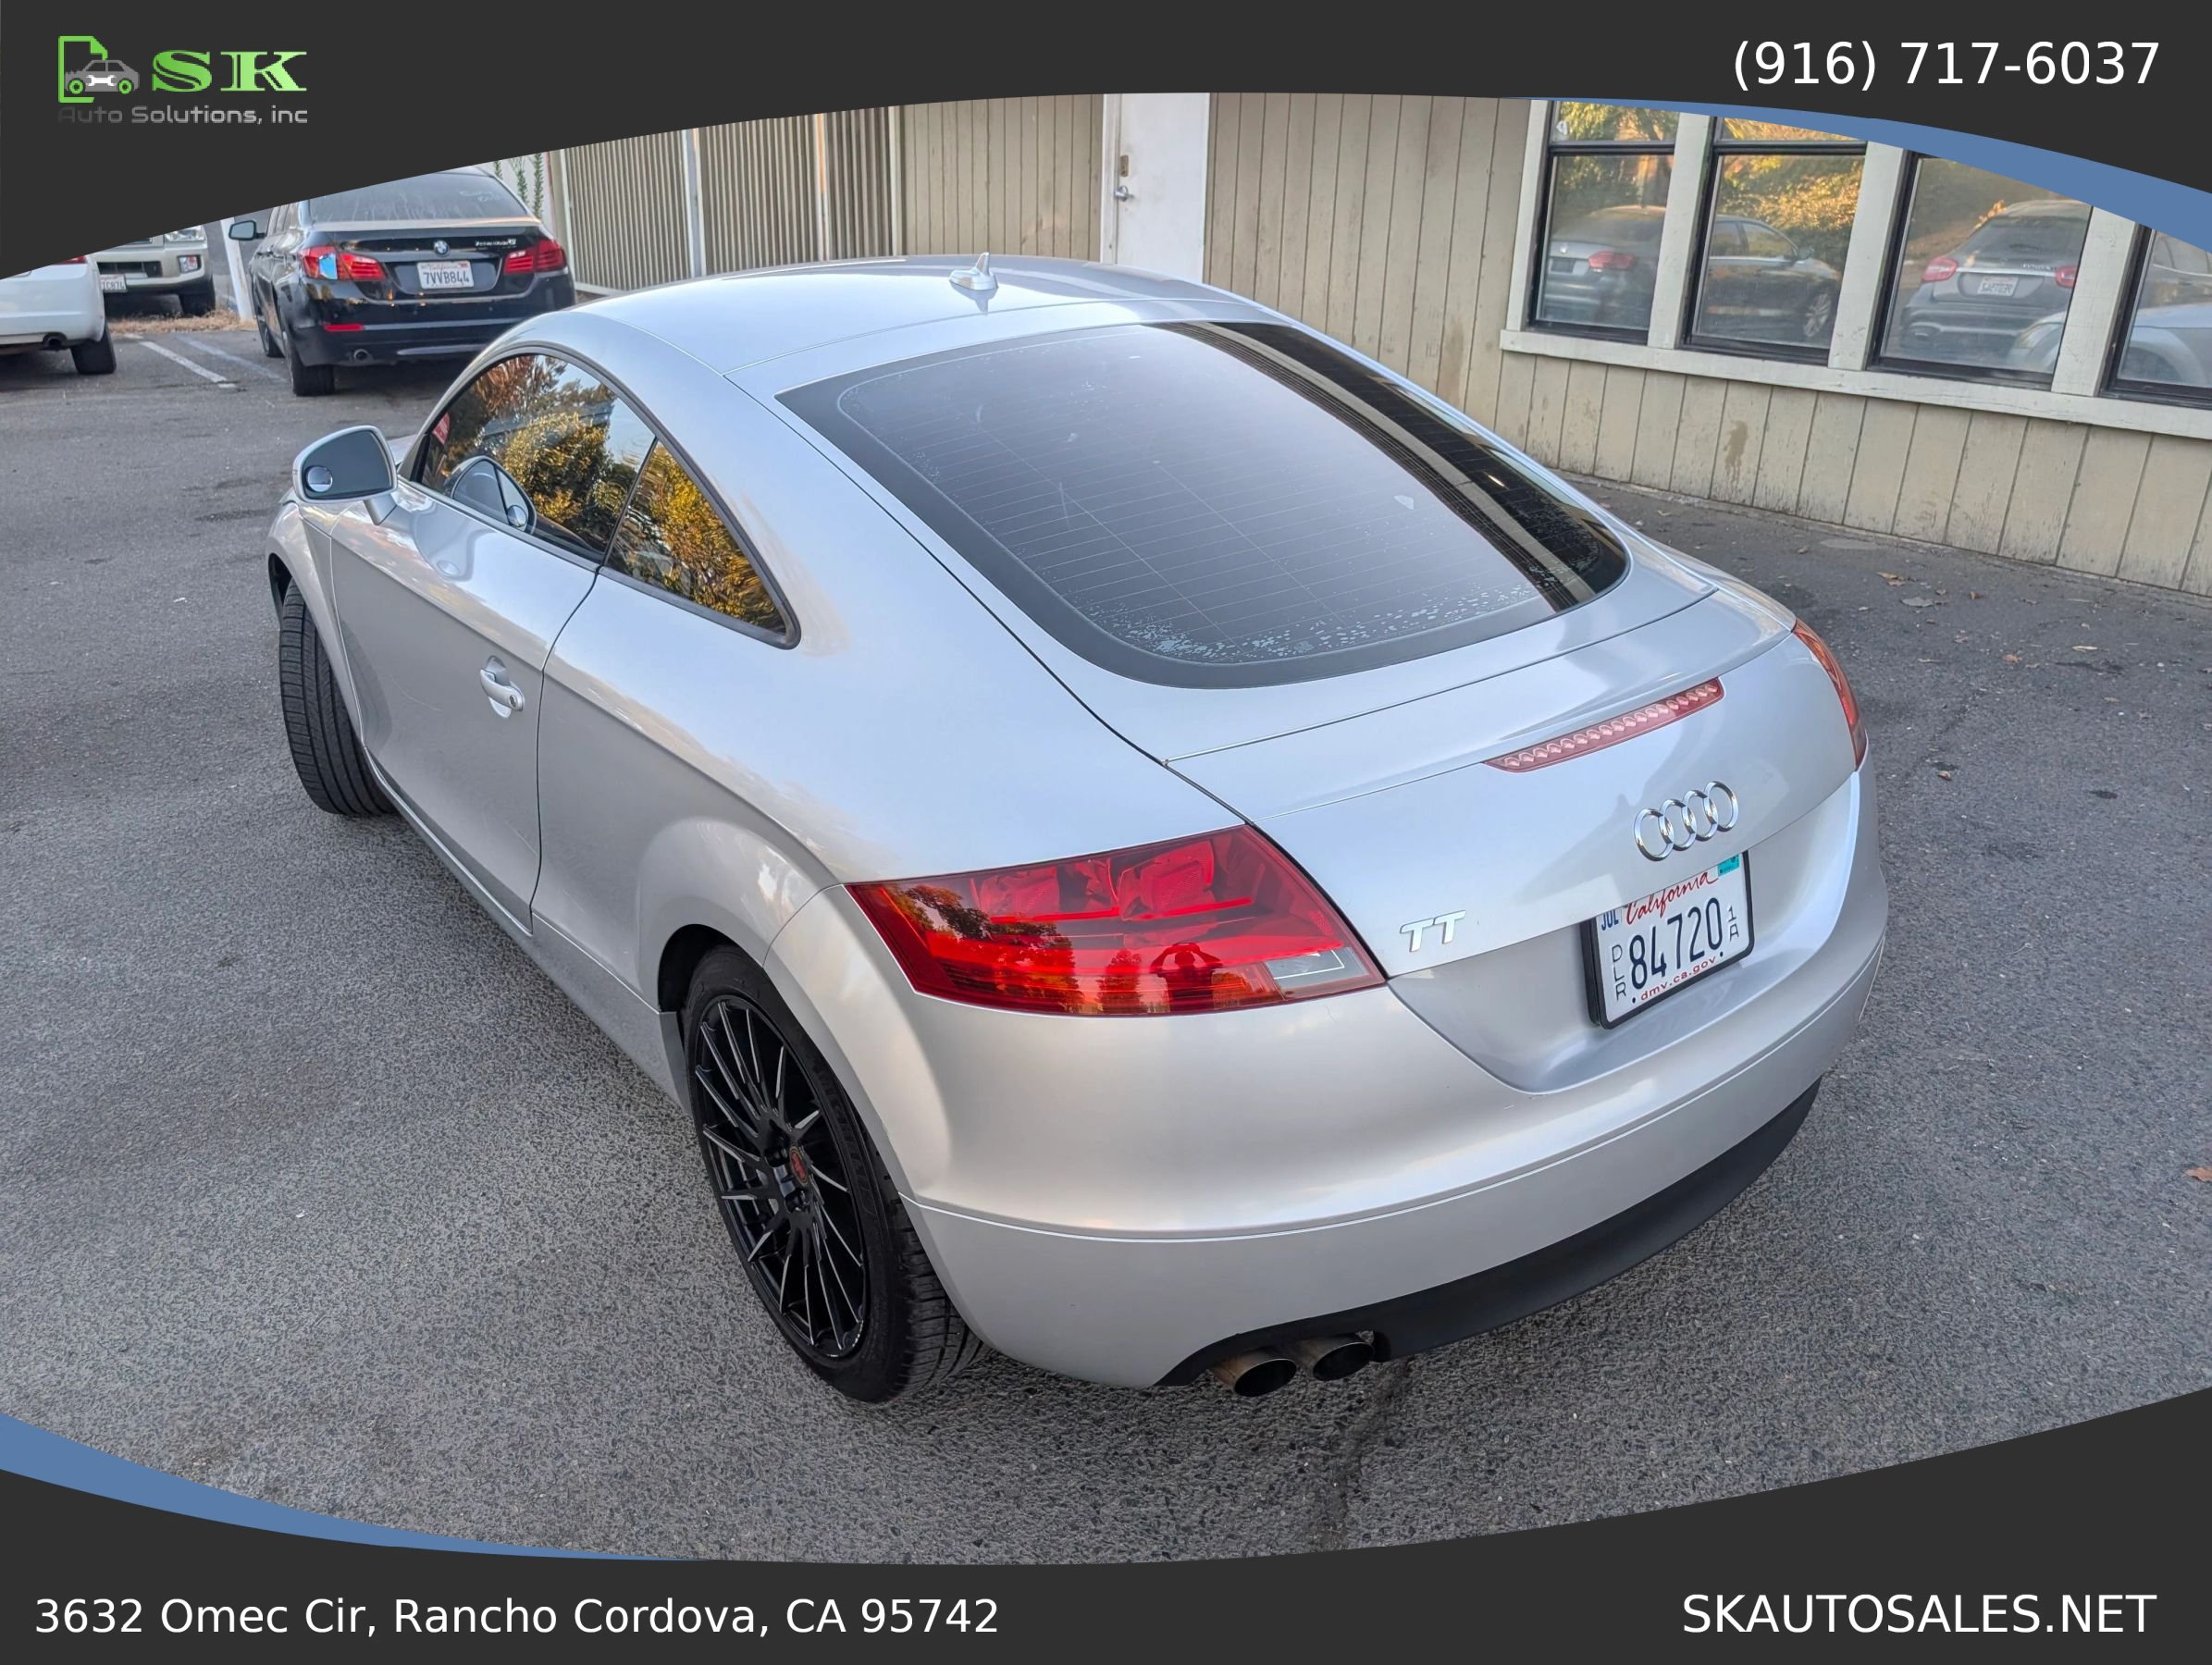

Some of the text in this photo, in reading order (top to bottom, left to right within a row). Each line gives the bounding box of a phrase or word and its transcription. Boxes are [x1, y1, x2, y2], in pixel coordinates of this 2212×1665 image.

[423, 270, 470, 285] 7VVB844
[1601, 909, 1619, 931] JUL
[1625, 871, 1719, 926] California
[1399, 910, 1466, 954] TT
[1629, 897, 1724, 990] 84720
[1641, 956, 1716, 1001] dmv.ca.gov
